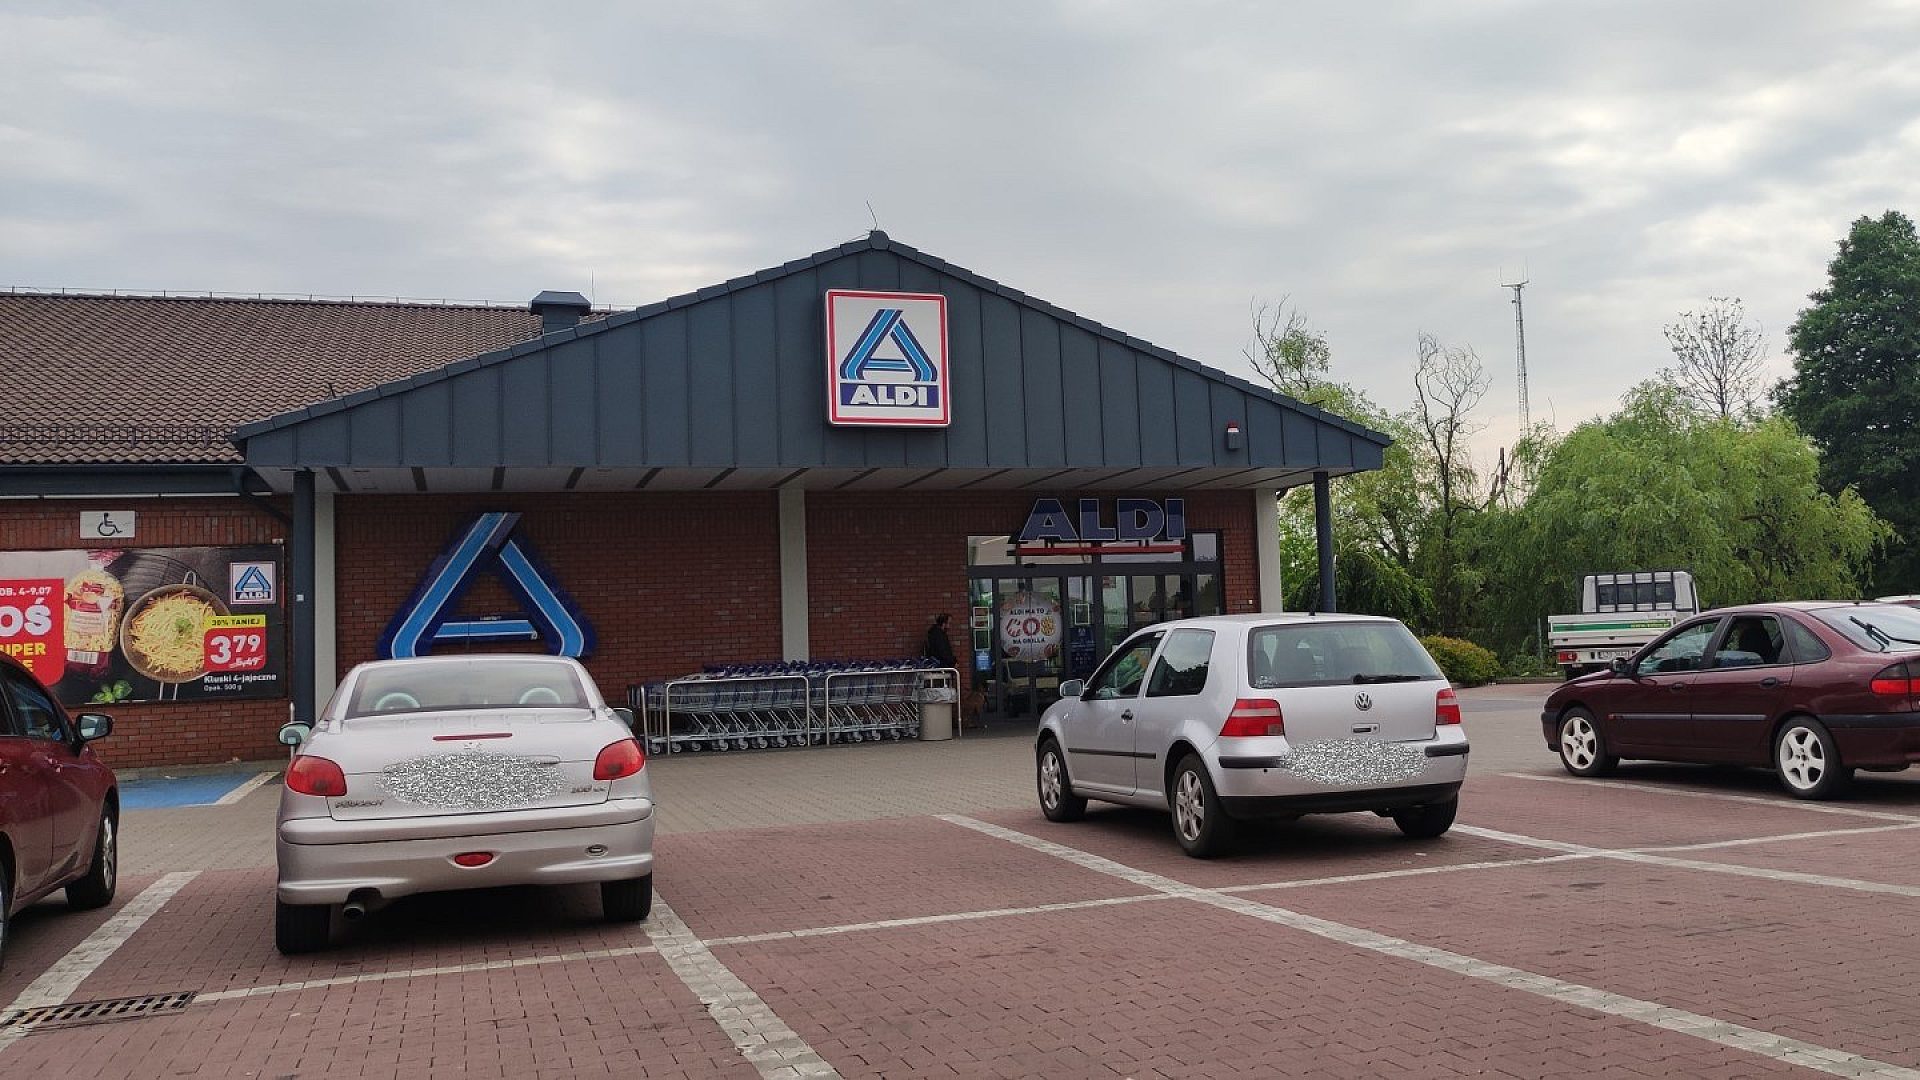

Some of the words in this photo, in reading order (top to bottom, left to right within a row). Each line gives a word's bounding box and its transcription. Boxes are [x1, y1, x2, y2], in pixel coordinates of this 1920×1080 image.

[850, 385, 928, 406] ALDI
[1019, 498, 1186, 541] ALDI
[239, 591, 269, 600] ALDI
[203, 675, 232, 683] Kluski
